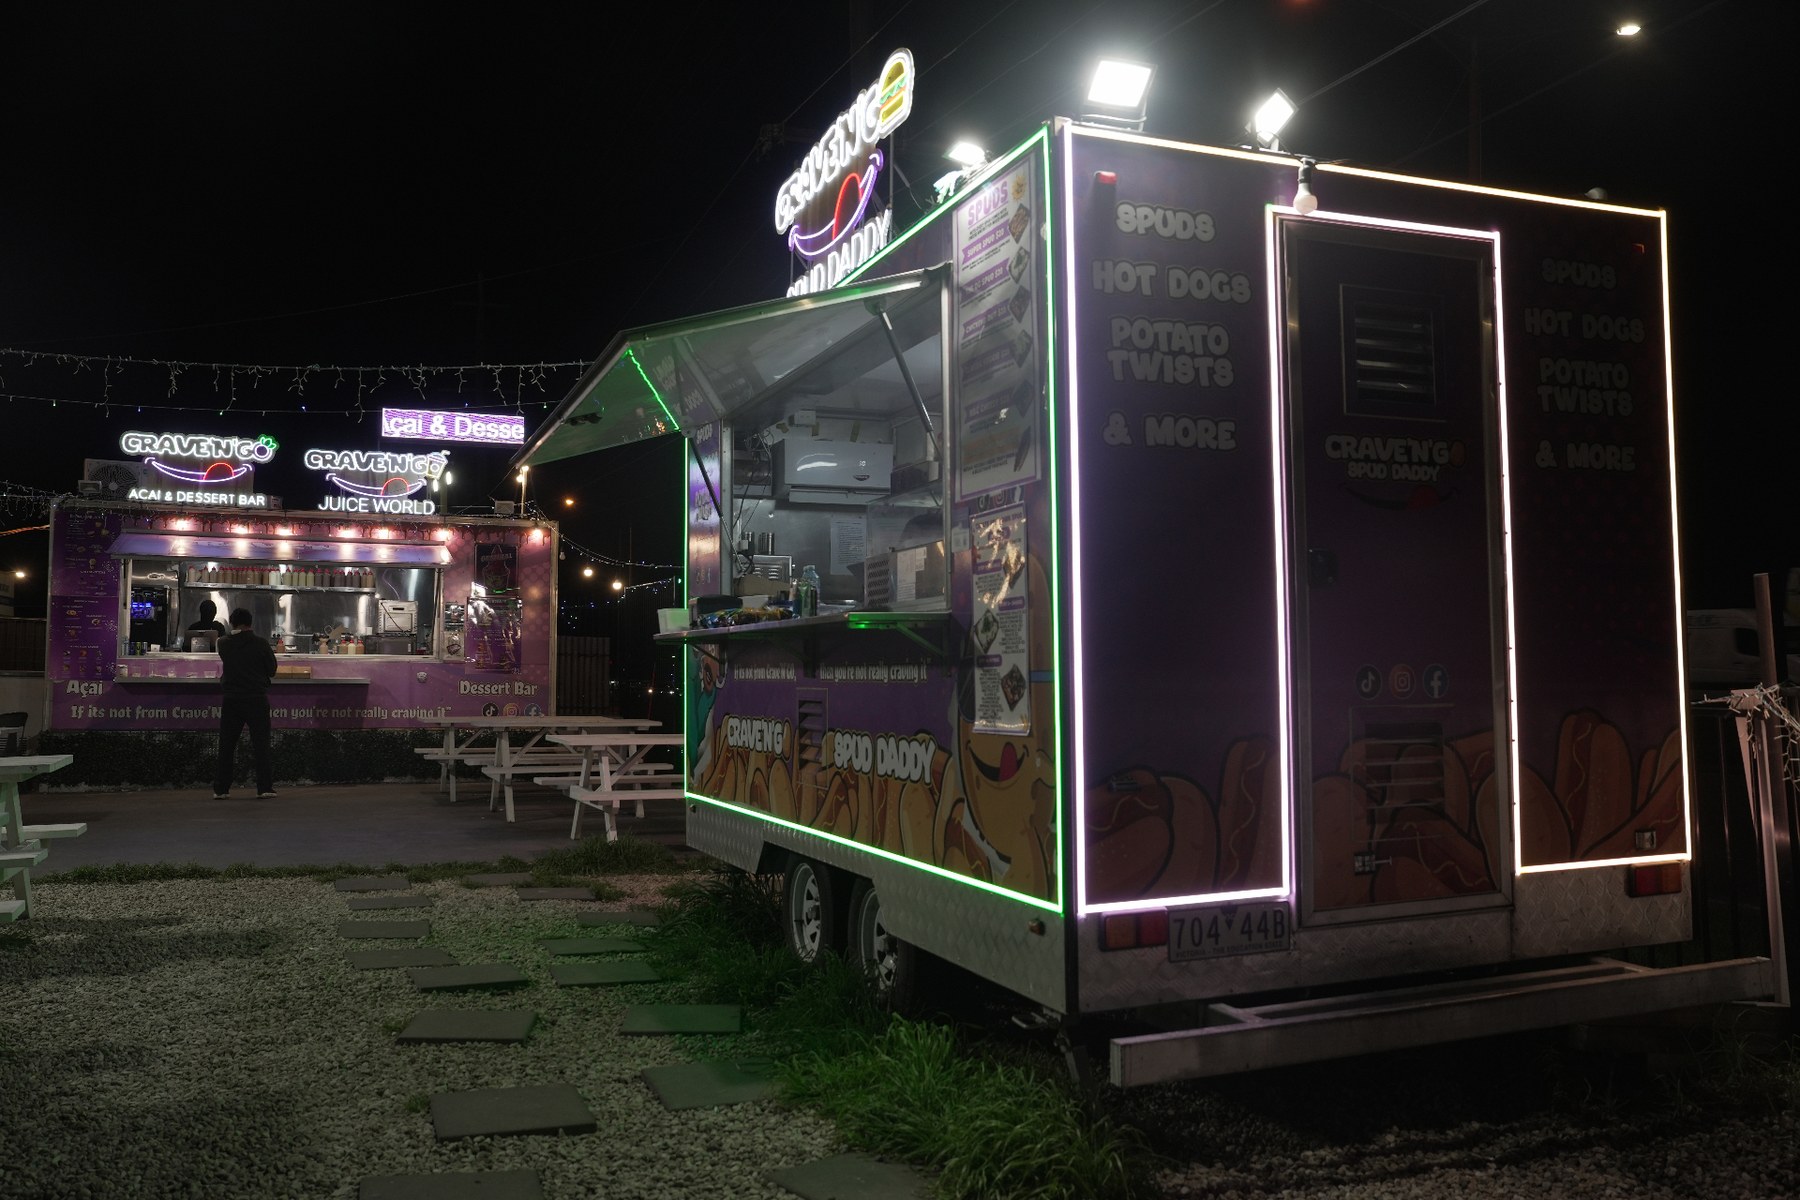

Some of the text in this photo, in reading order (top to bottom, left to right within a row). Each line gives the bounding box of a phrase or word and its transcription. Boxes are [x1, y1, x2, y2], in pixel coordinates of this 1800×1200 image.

[968, 181, 1008, 226] SPUDS
[1116, 203, 1215, 242] SPUDS
[827, 208, 893, 290] DADDY
[1092, 260, 1251, 303] HOT DOGS
[1542, 257, 1616, 289] SPUDS
[1111, 316, 1230, 356] POTATO
[1524, 307, 1647, 344] HOT DOGS
[1107, 350, 1234, 387] TWISTS
[1539, 357, 1629, 390] POTATO
[1537, 385, 1633, 417] TWISTS
[430, 415, 448, 435] &
[1103, 412, 1237, 450] & MORE
[1348, 462, 1440, 481] SPUD DADDY
[1535, 439, 1635, 472] & MORE
[128, 488, 266, 506] ACAI & DESSERT BAR
[318, 495, 436, 516] JUICE WORLD
[856, 661, 867, 680] not
[868, 658, 889, 683] really
[890, 657, 919, 684] craving
[66, 680, 103, 698] Açai
[459, 680, 538, 697] Dessert Bar
[88, 705, 105, 718] its
[109, 706, 132, 718] not
[135, 705, 168, 719] from
[269, 707, 288, 718] en
[290, 705, 328, 720] you're
[332, 706, 353, 718] not
[355, 706, 388, 719] really
[391, 706, 434, 719] craving
[834, 731, 873, 774] SPUD
[877, 734, 936, 785] DADDY
[1172, 908, 1286, 950] 704 44B
